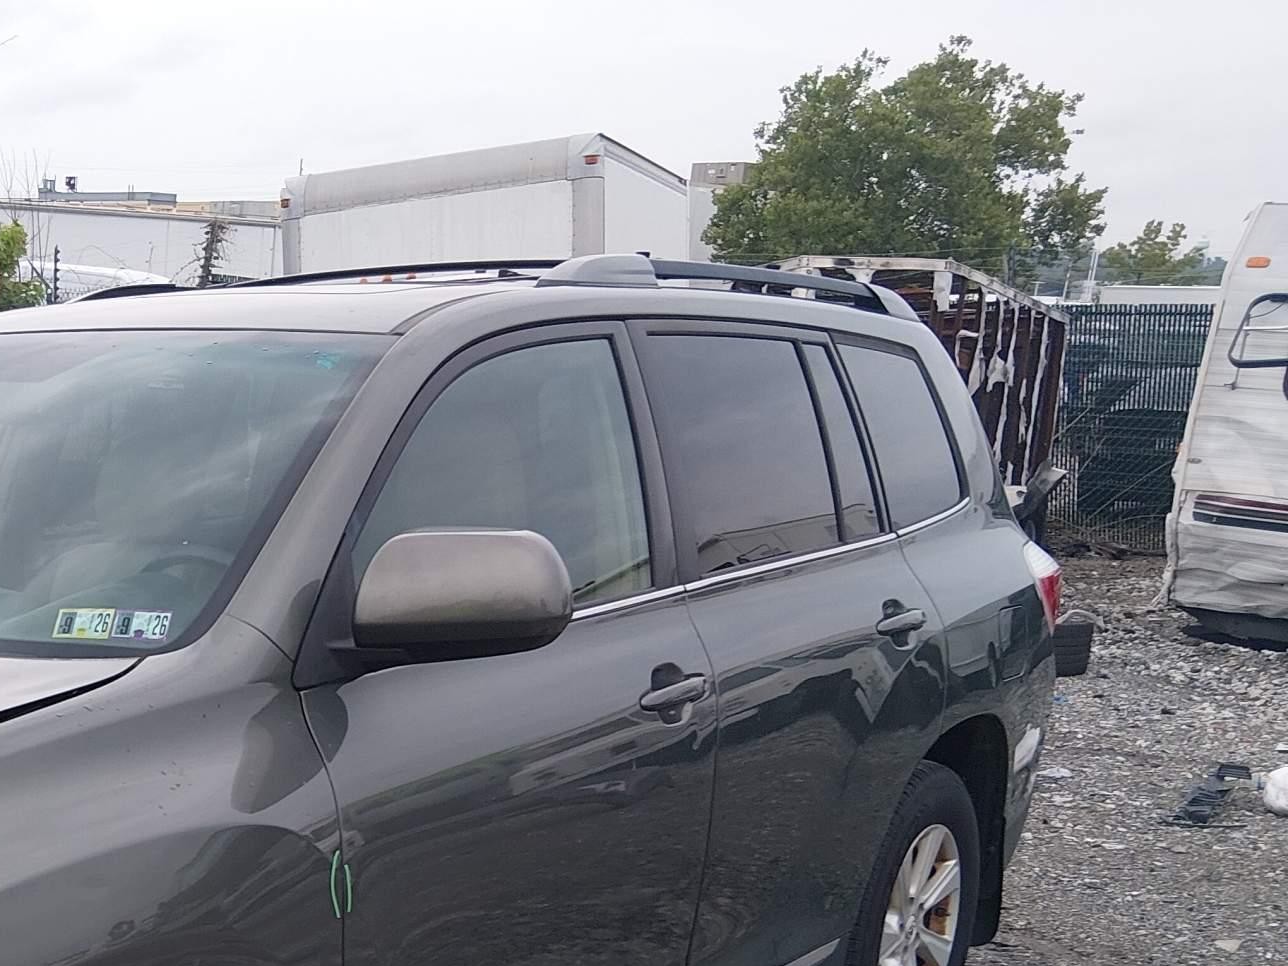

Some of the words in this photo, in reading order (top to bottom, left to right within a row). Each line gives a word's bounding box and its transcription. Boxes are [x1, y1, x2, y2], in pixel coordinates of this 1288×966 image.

[62, 616, 73, 634] 9
[94, 613, 111, 633] 26
[119, 616, 131, 635] 9
[152, 615, 169, 636] 26
